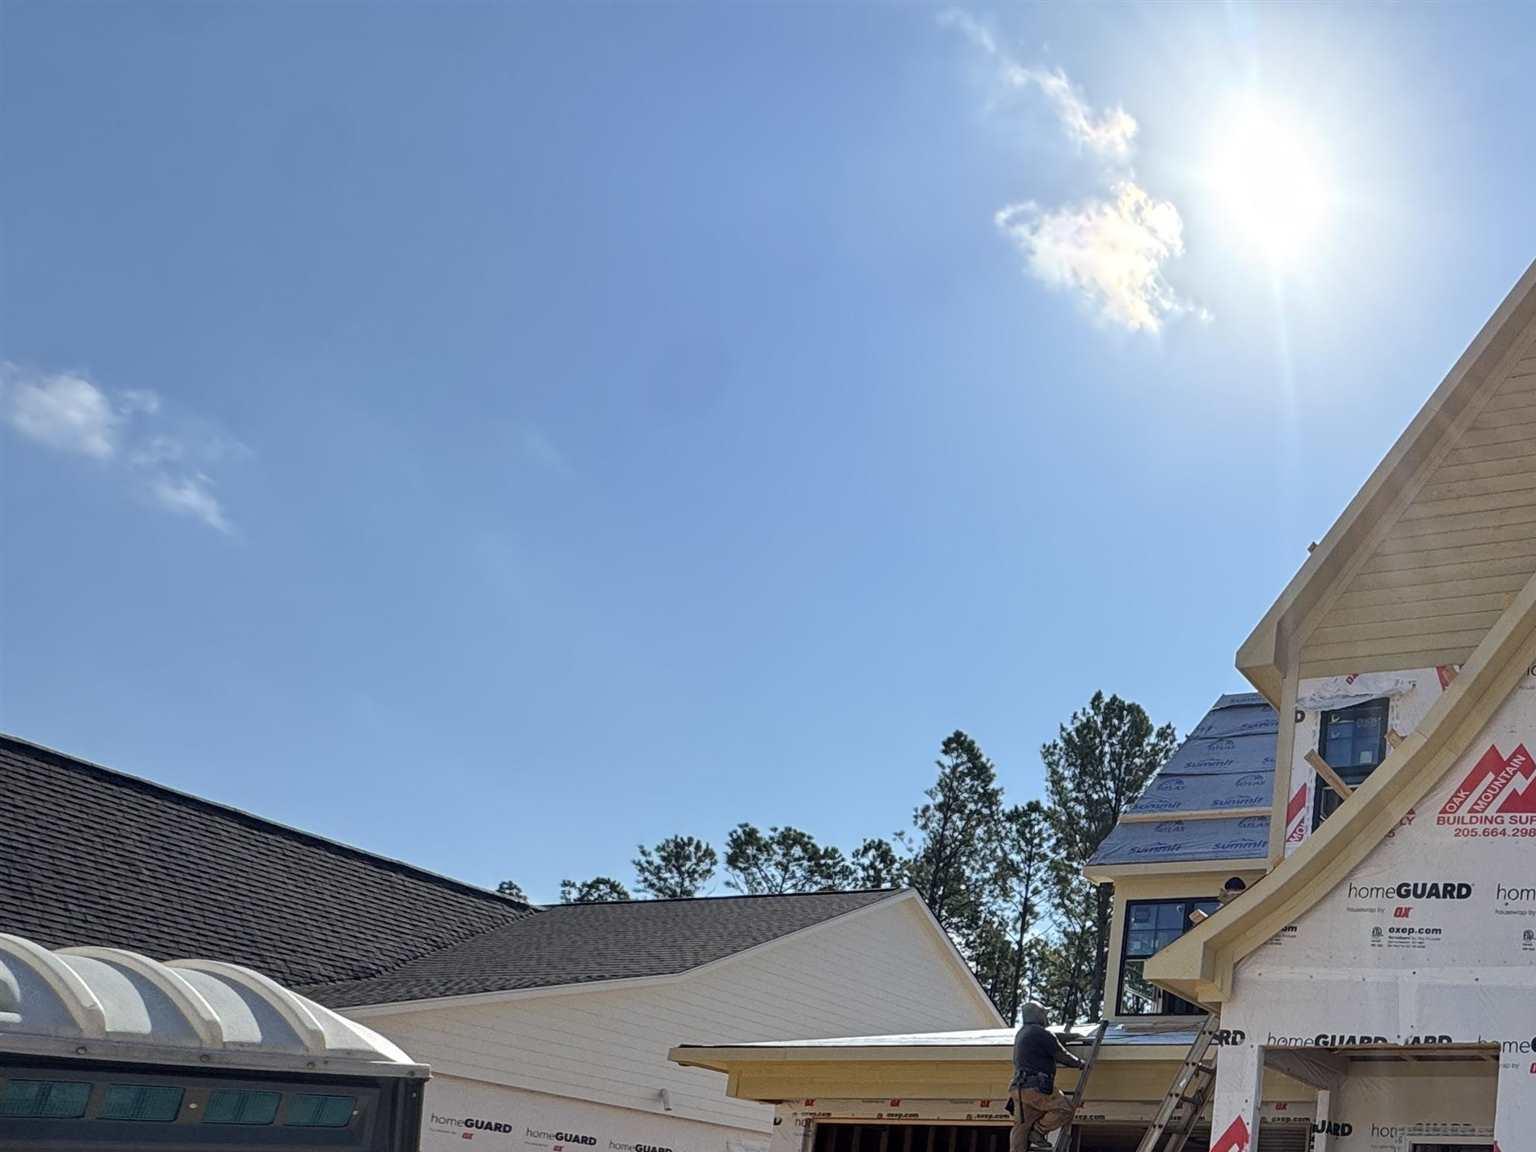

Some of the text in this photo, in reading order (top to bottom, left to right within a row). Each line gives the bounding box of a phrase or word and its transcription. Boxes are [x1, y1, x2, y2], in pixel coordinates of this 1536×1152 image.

[1474, 754, 1526, 813] MOUNTAIN
[1446, 788, 1470, 813] OAK
[1436, 814, 1504, 826] BUILDING
[1348, 882, 1472, 900] homeGUARD
[1394, 907, 1413, 918] OX
[1388, 926, 1442, 937] oxep.com
[430, 1112, 512, 1134] homeGUARD
[526, 1127, 597, 1146] homeGUARD
